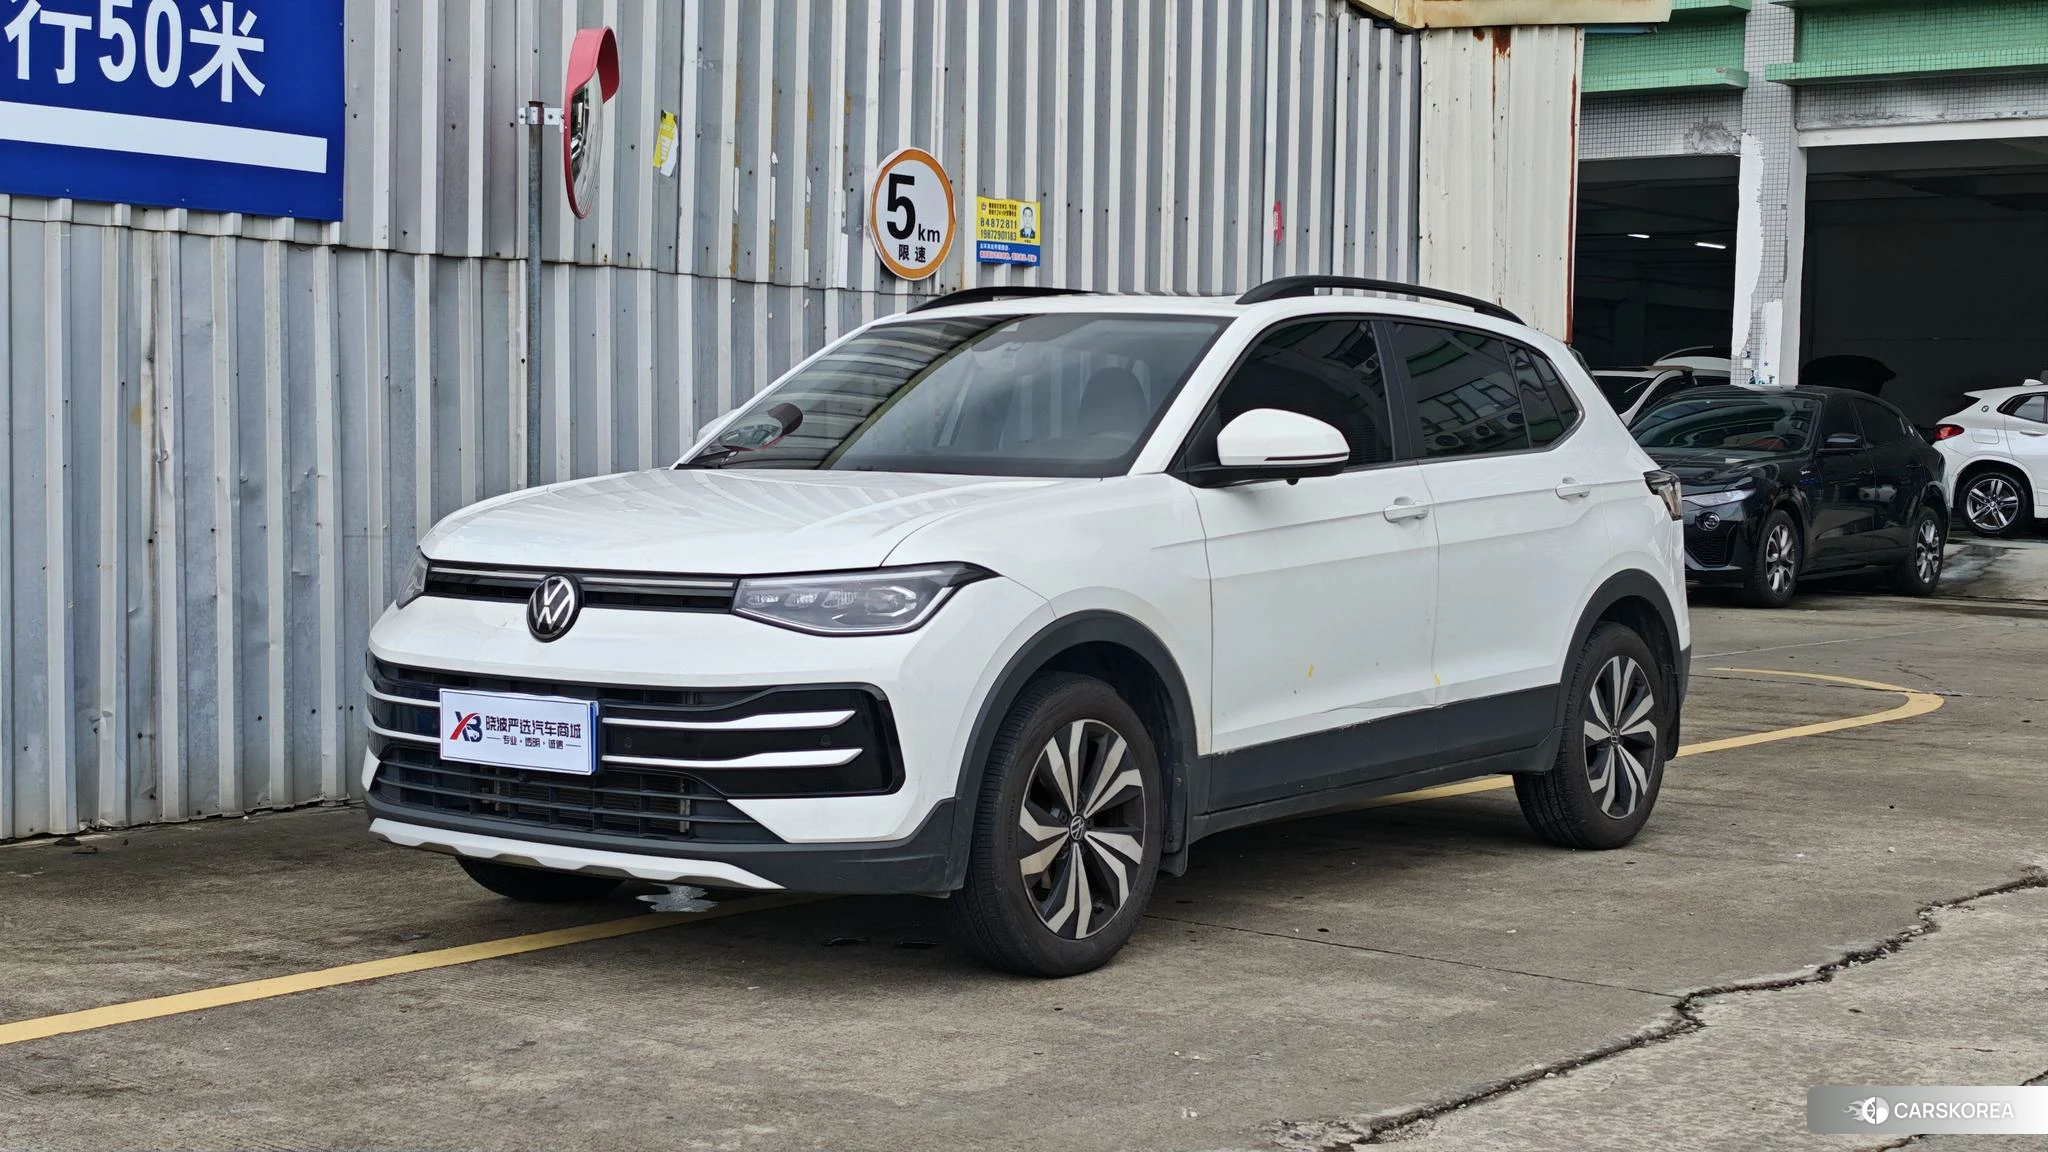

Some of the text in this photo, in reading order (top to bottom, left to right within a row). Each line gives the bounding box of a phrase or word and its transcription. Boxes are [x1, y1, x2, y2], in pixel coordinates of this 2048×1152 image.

[4, 0, 266, 103] 行50米
[886, 172, 940, 243] 5 km
[898, 243, 927, 263] 限速
[485, 715, 582, 739] 晓波严选汽车商城
